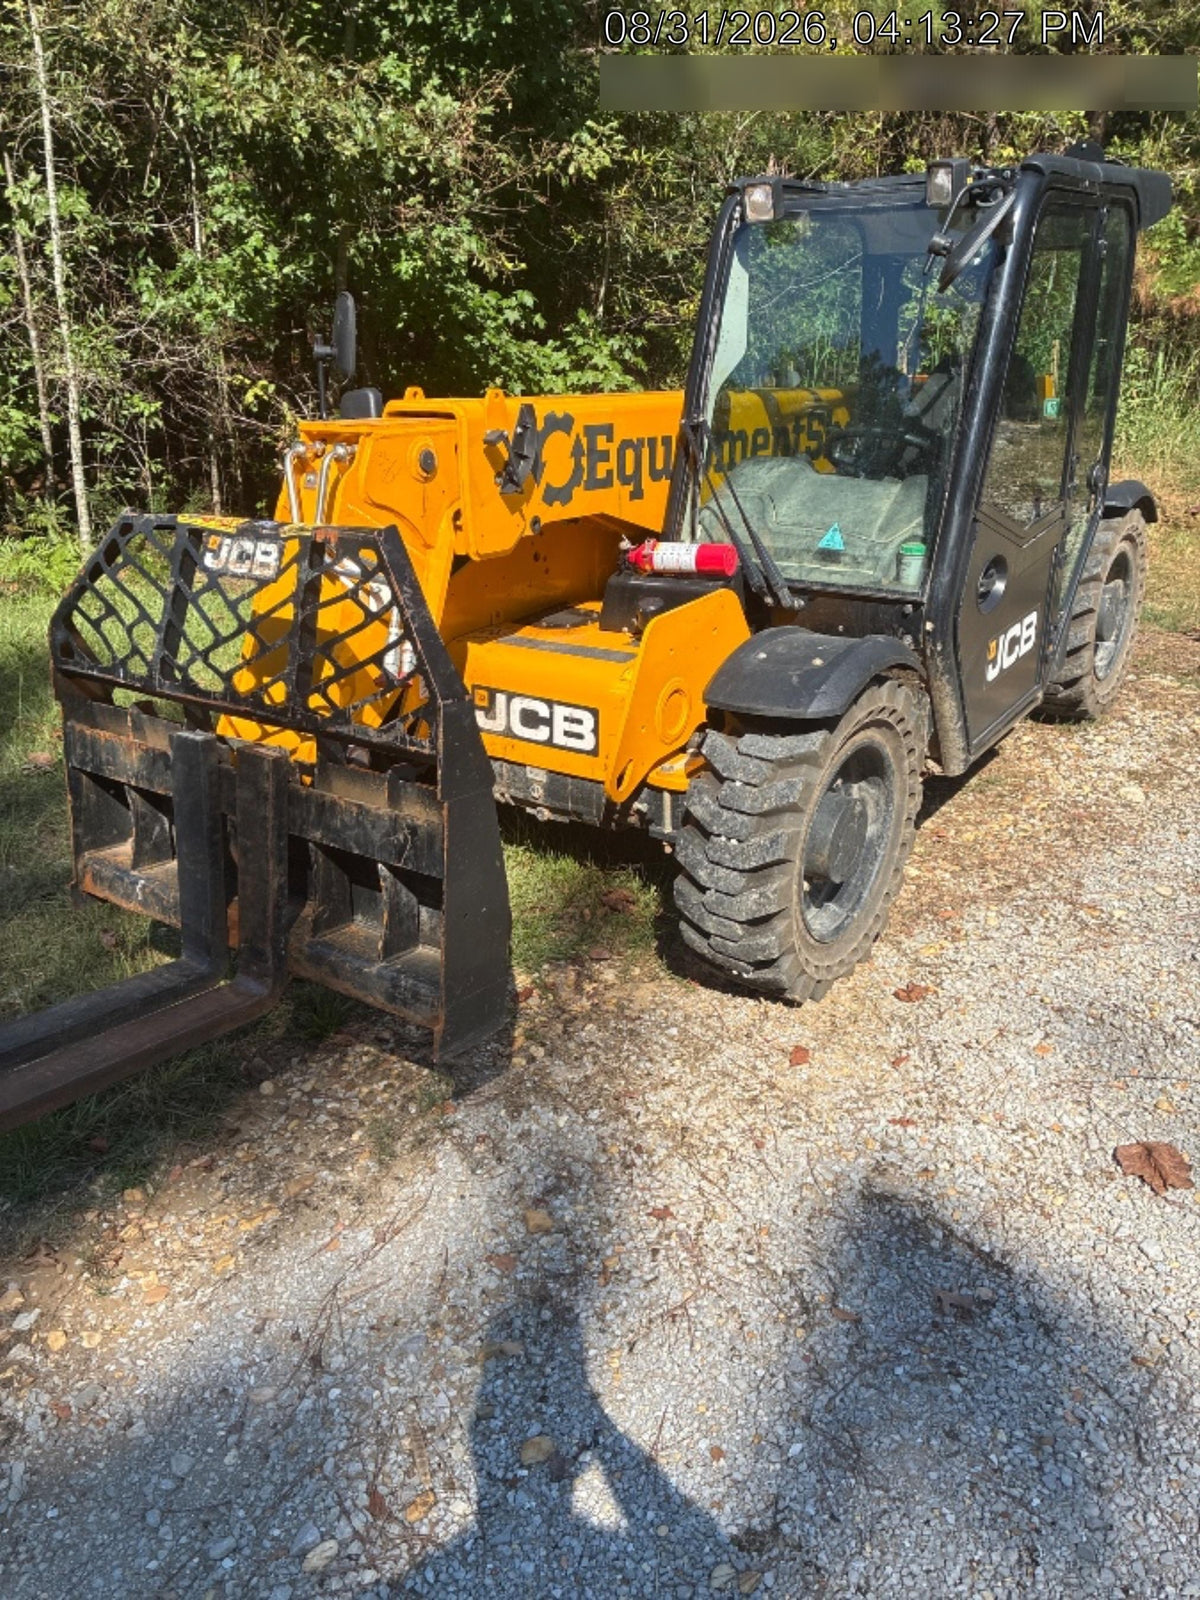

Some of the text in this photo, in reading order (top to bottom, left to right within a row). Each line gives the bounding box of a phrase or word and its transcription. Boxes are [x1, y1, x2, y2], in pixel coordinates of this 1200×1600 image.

[203, 536, 279, 578] JCB
[986, 611, 1038, 682] JCB
[474, 691, 597, 752] JCB
